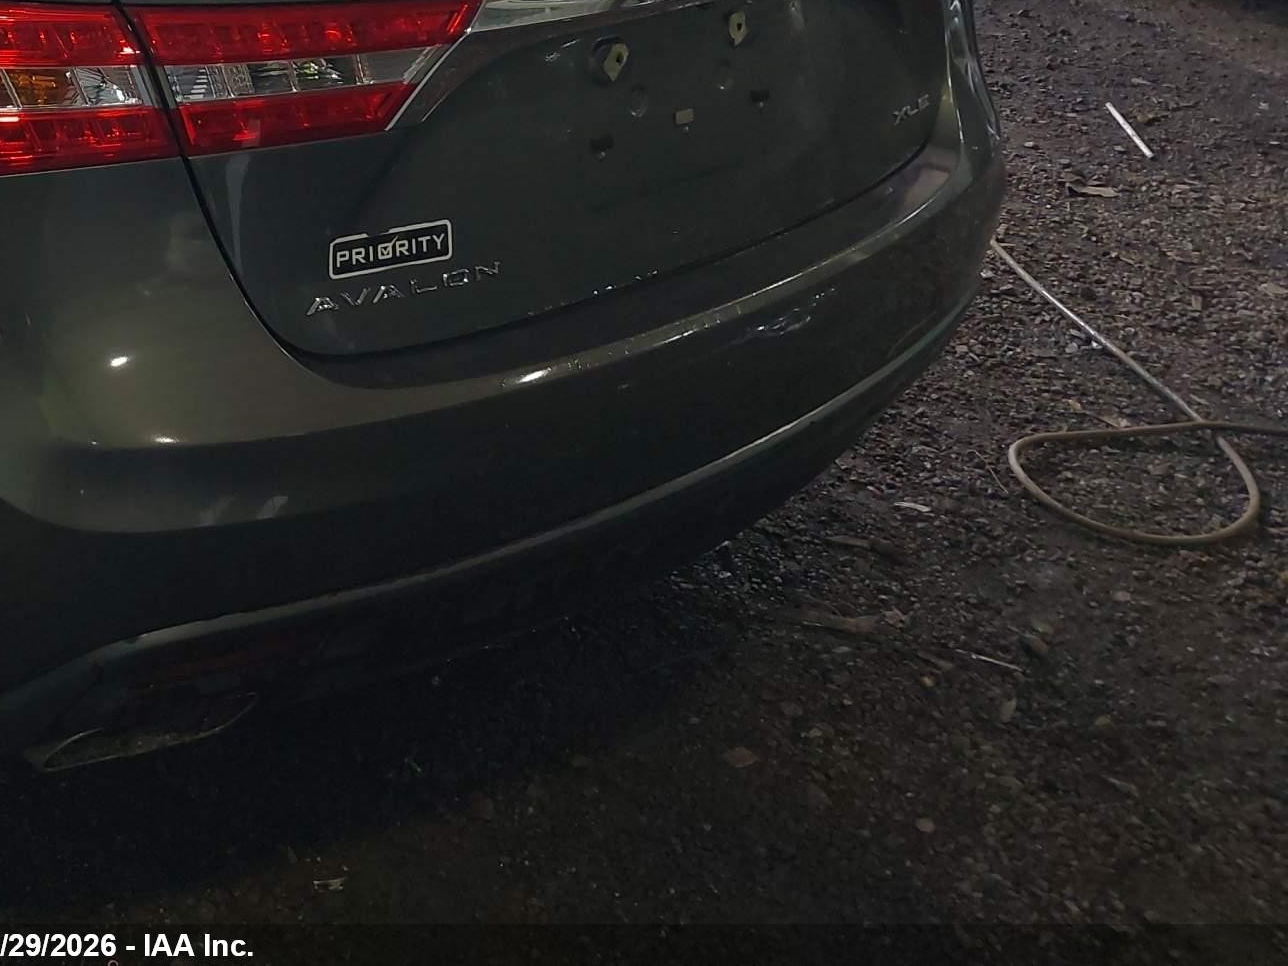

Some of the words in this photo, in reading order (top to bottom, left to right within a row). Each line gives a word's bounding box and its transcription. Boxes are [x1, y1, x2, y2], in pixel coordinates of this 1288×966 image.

[892, 93, 930, 126] XLE
[335, 233, 446, 268] PRIORITY
[305, 260, 502, 316] AVALON
